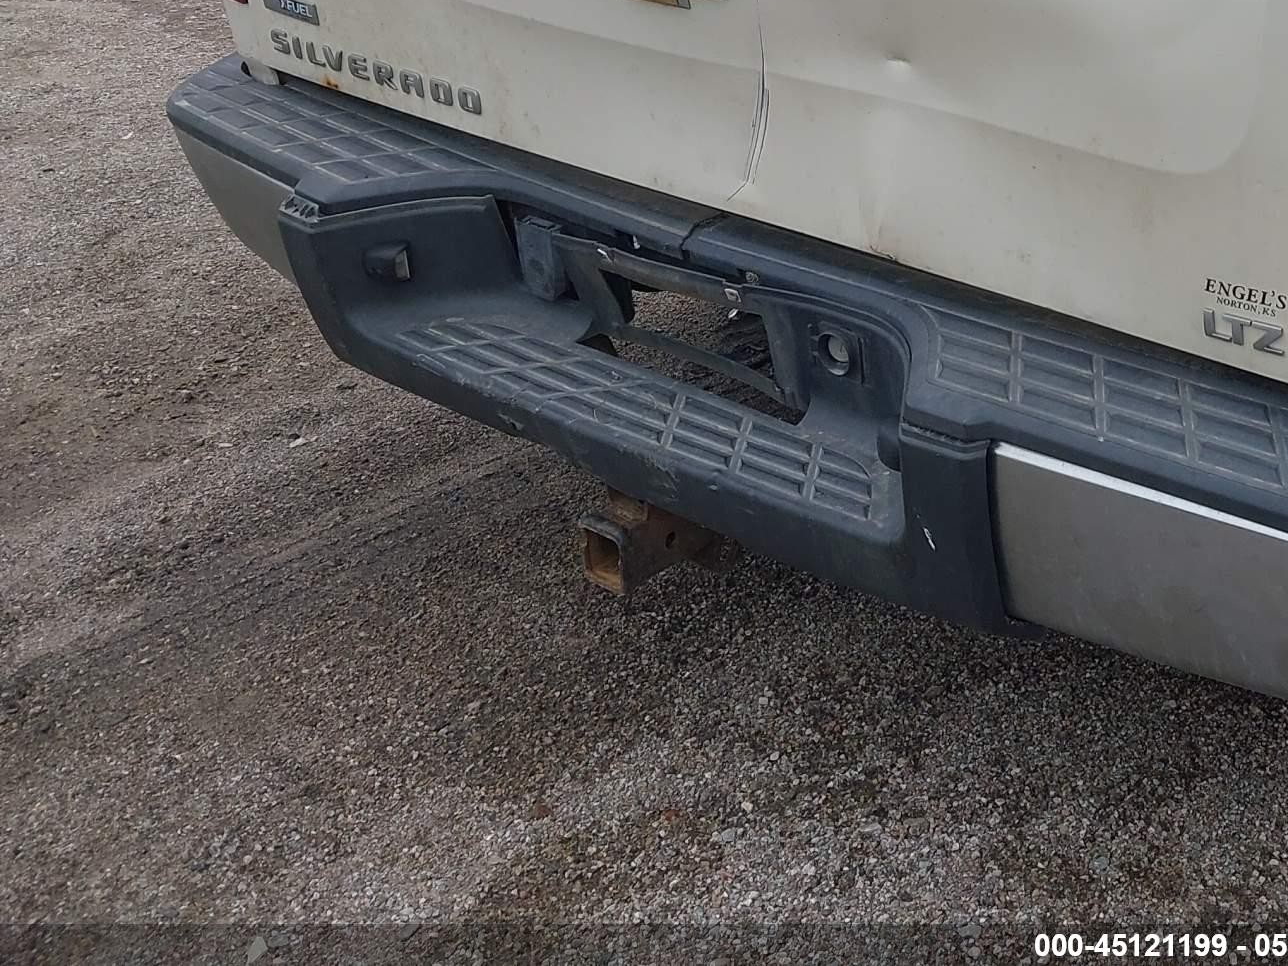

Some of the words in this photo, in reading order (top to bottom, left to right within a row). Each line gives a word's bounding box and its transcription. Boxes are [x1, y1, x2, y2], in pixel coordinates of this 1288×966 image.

[270, 29, 482, 115] SILVERADO
[1204, 277, 1288, 310] ENGEL'S
[1261, 307, 1277, 318] KS
[1203, 307, 1285, 356] LTZ
